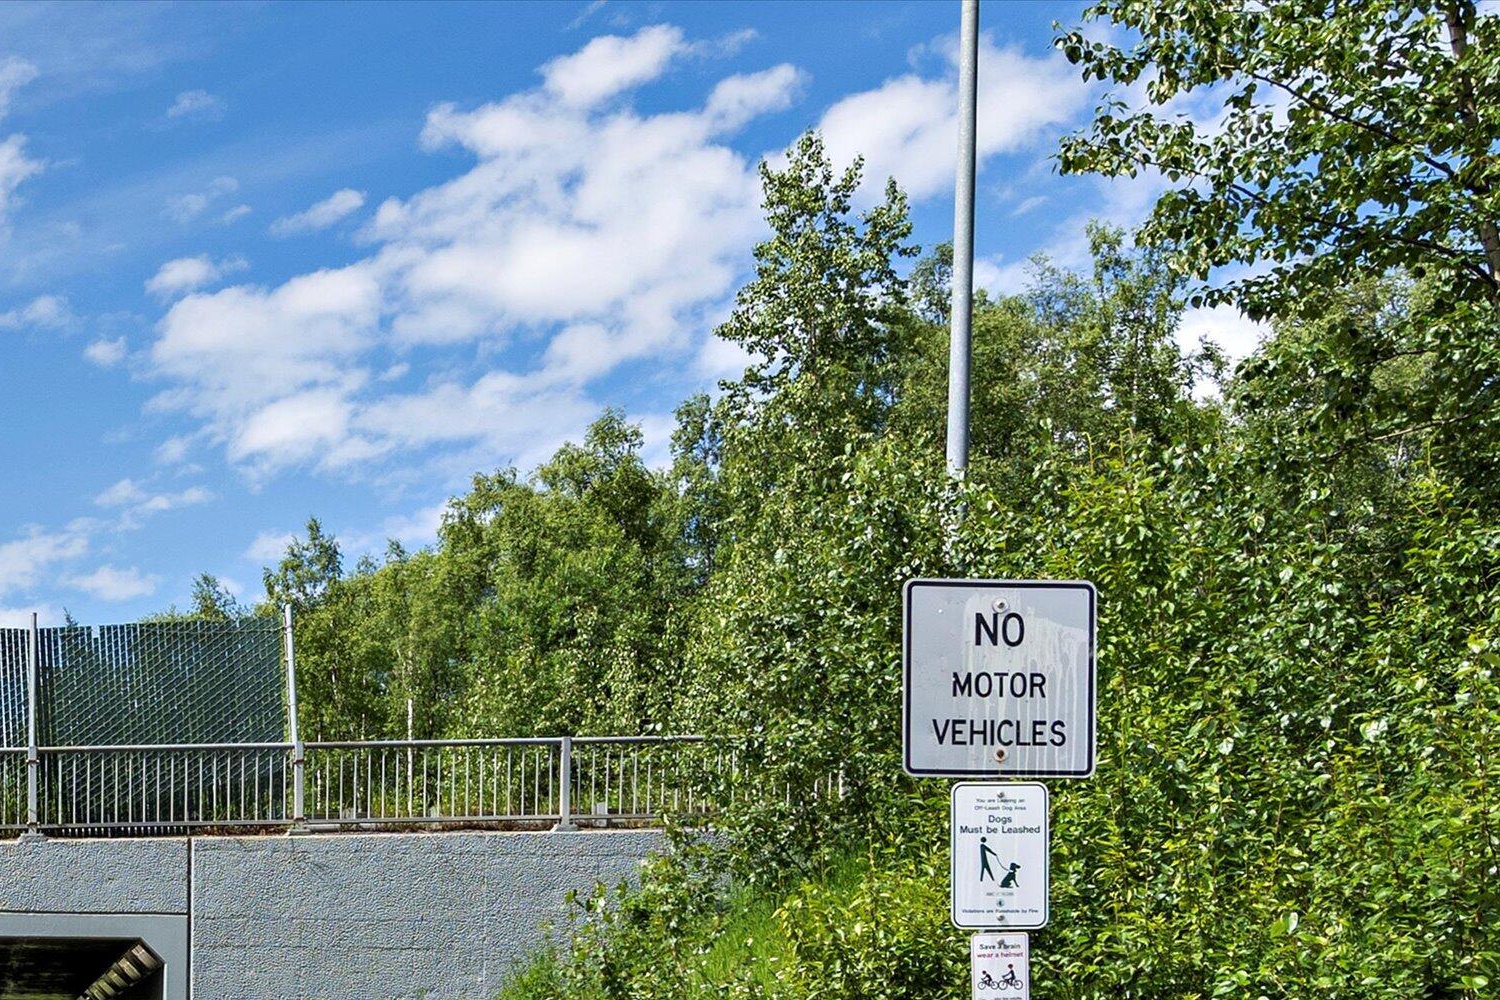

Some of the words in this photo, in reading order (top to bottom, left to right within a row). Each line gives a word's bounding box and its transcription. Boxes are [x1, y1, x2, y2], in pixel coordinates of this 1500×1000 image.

[975, 612, 1025, 647] NO
[952, 672, 1046, 698] MOTOR
[932, 719, 1066, 746] VEHICLES
[960, 826, 982, 834] Must
[986, 826, 998, 834] be
[1001, 826, 1040, 834] Leashed
[988, 815, 1012, 824] Dogs
